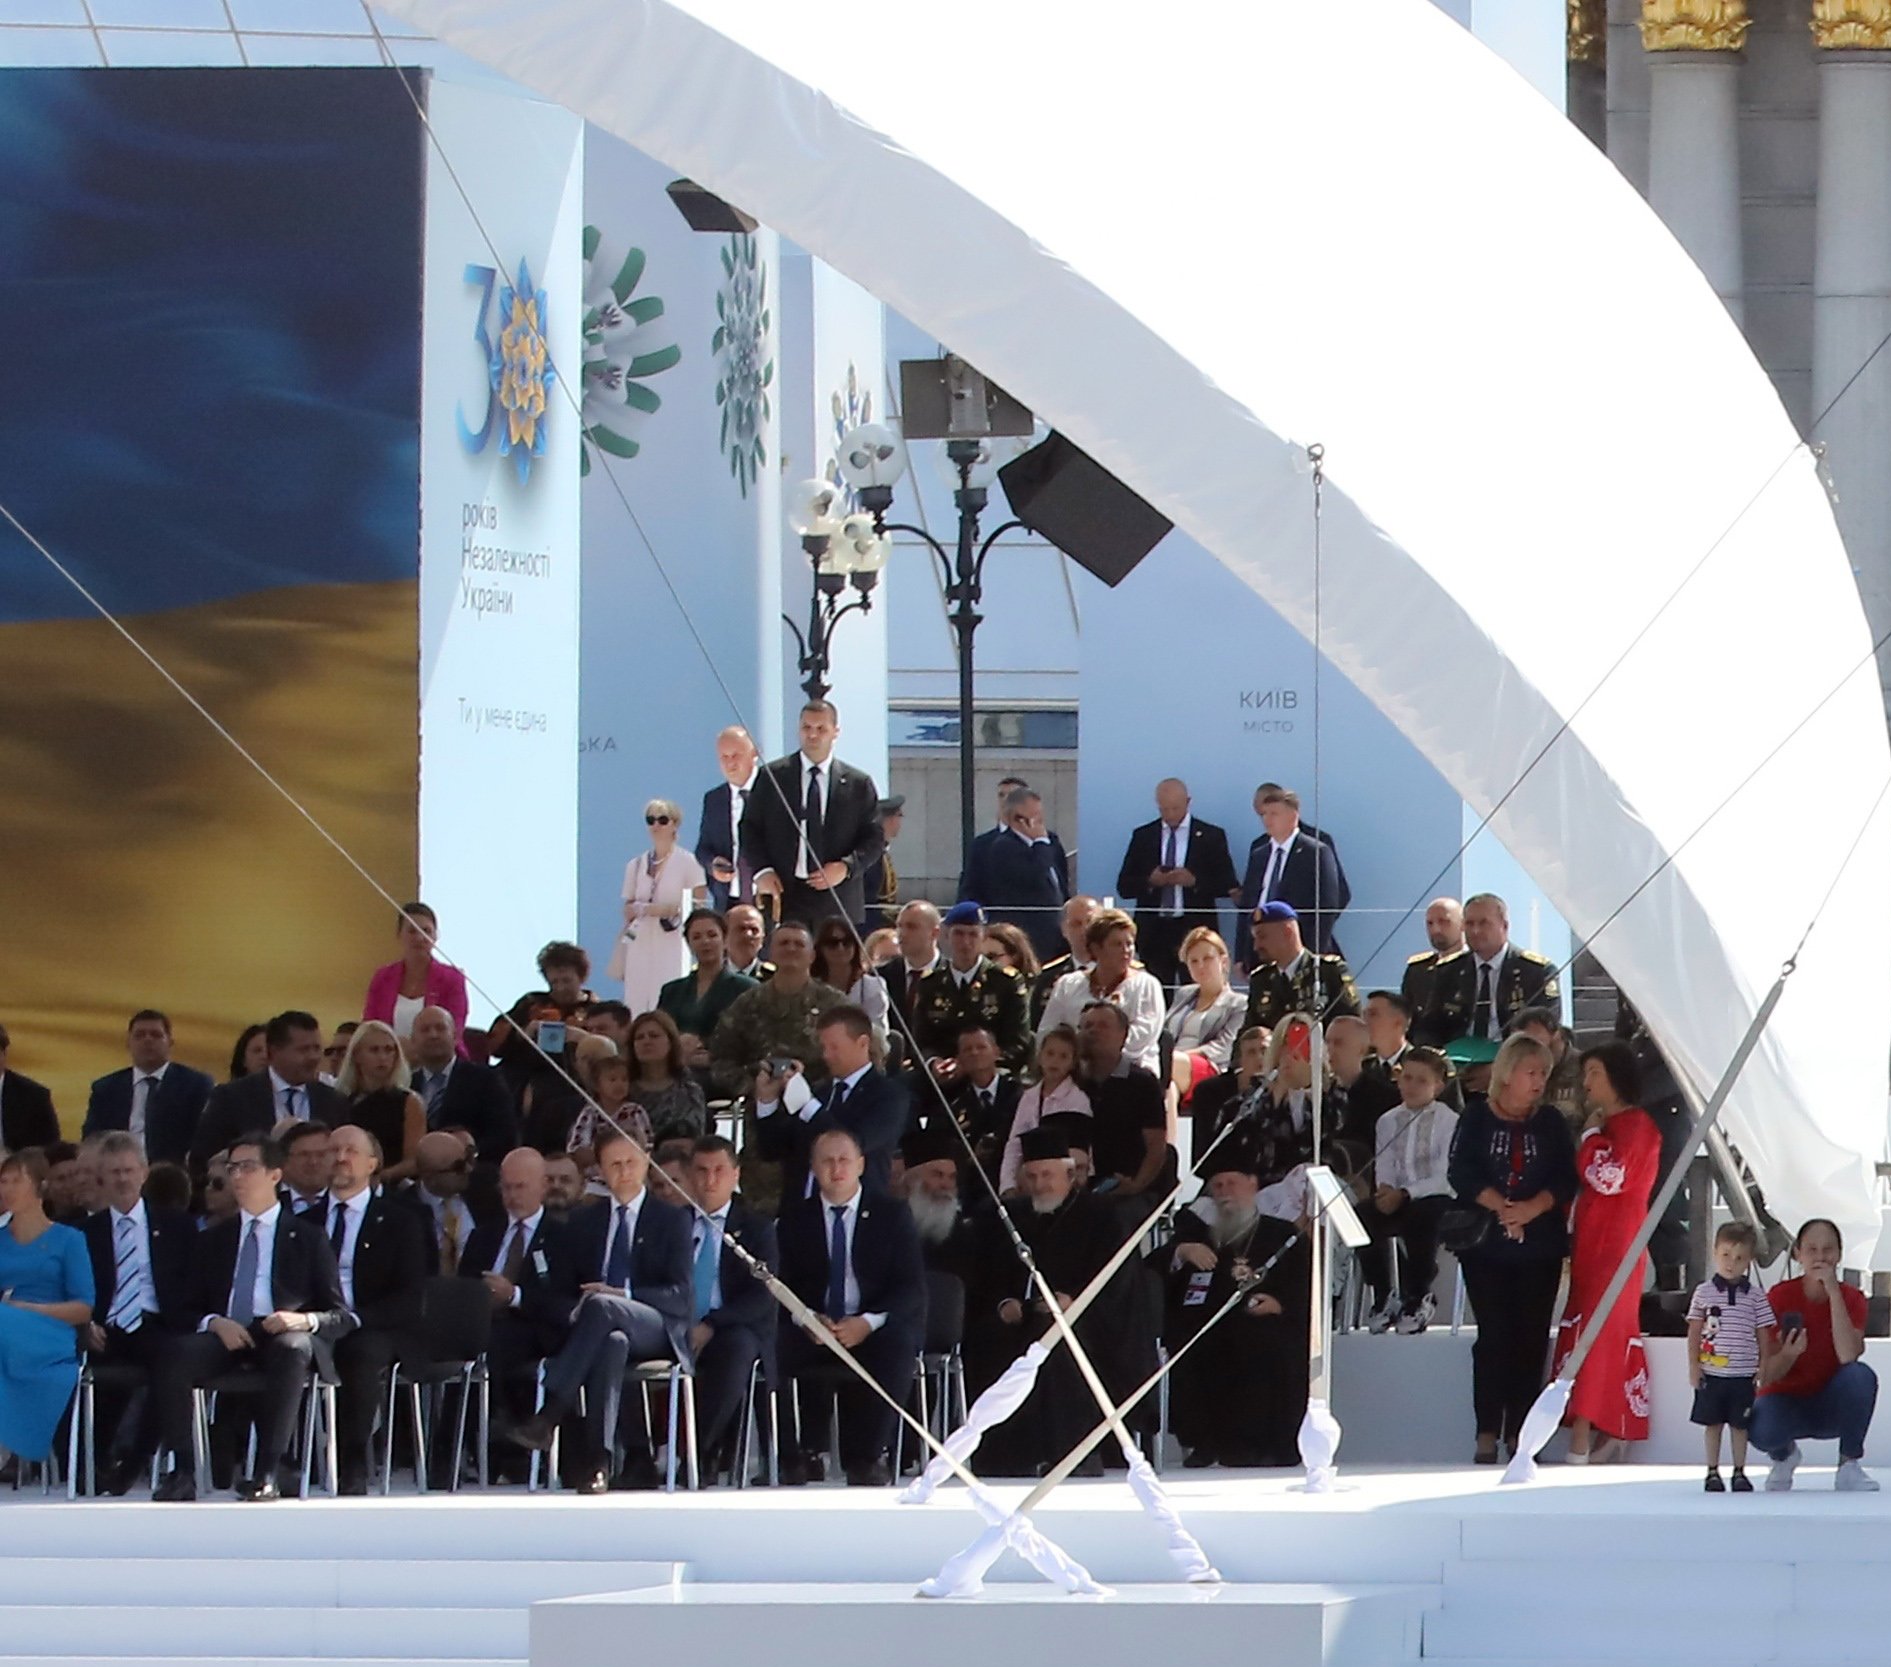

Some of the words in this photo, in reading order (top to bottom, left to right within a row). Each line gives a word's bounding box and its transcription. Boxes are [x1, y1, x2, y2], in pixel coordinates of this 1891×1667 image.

[461, 497, 498, 532] років
[461, 535, 551, 580] Незалежності
[461, 576, 514, 621] України
[1240, 687, 1298, 709] КИЇВ
